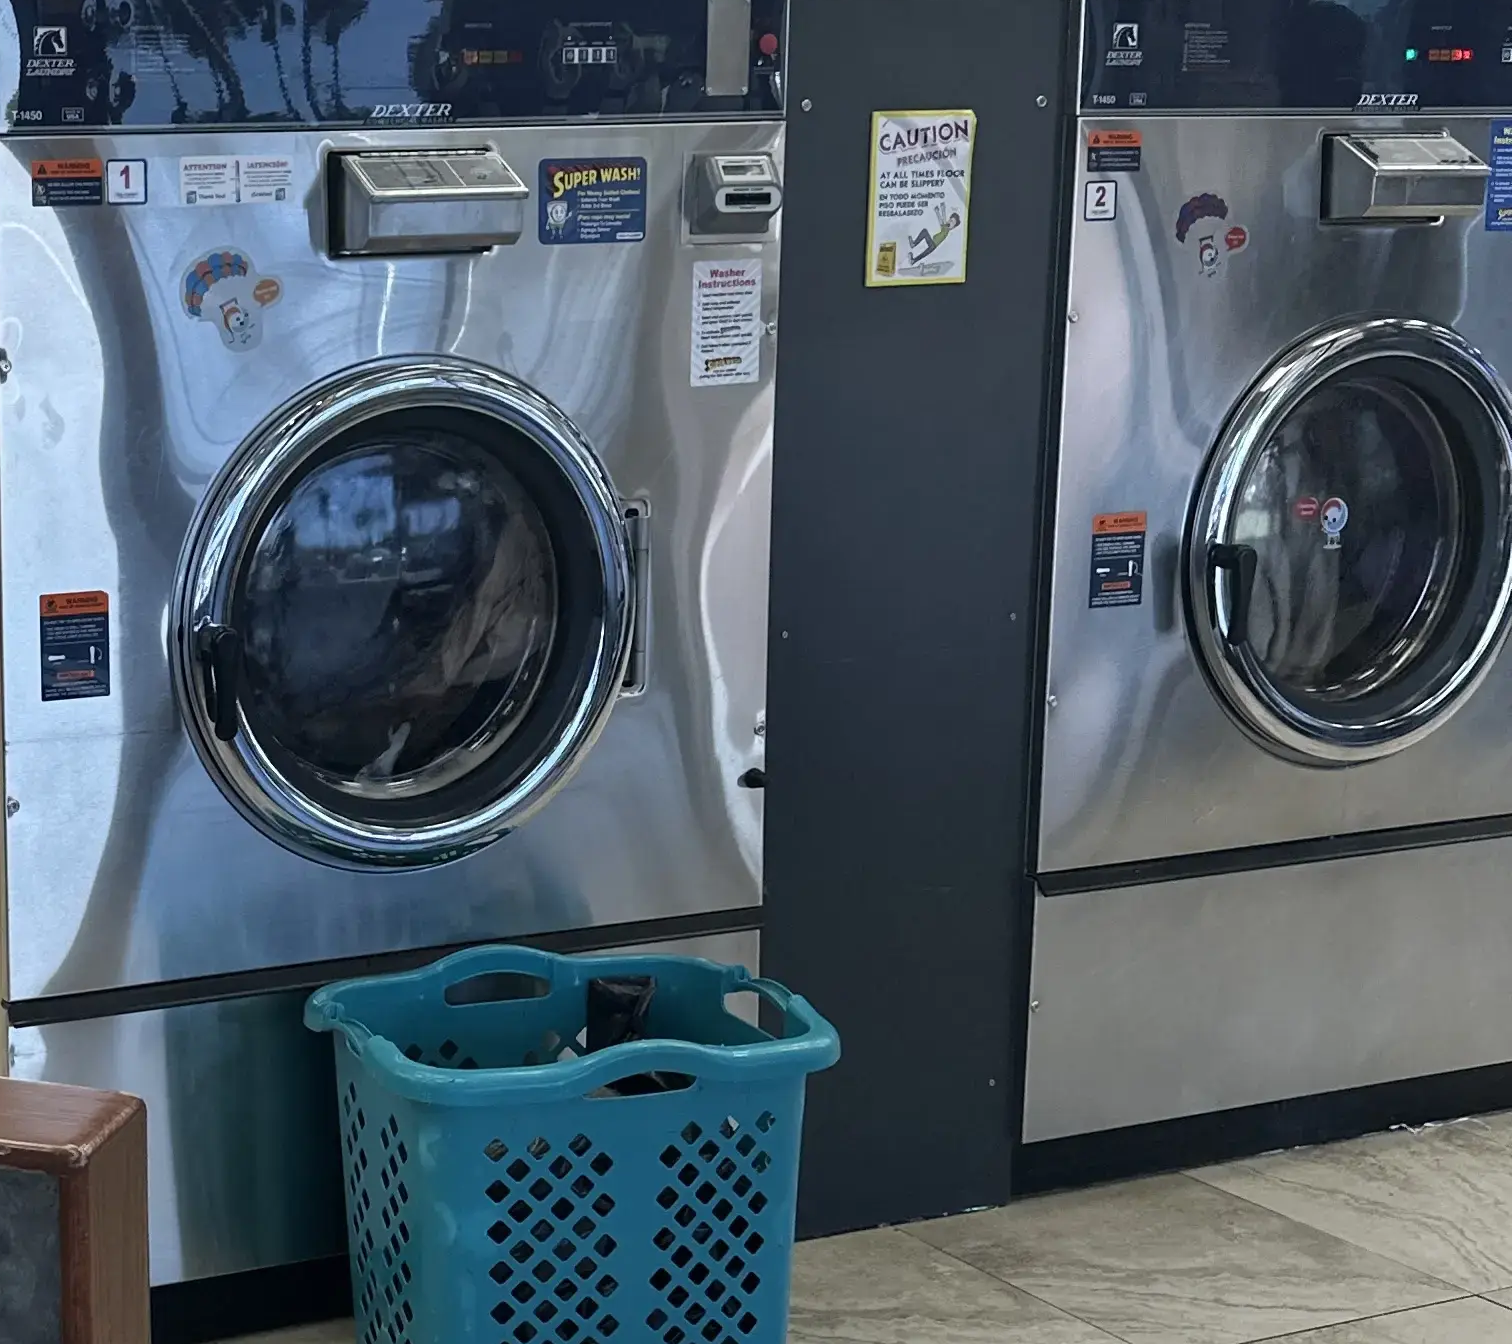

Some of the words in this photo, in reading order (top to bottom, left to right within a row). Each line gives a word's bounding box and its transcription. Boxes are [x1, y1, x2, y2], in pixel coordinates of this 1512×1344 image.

[1106, 51, 1143, 59] DEXTER
[26, 58, 76, 69] DEXTER
[26, 68, 77, 77] LAUNDRY
[1092, 94, 1117, 105] T-1450
[1356, 93, 1419, 106] DEXTER
[11, 110, 43, 121] T-1450
[369, 103, 453, 118] DEXTER
[879, 120, 969, 153] CAUTION
[897, 147, 957, 168] PRECAUCIÓN
[119, 165, 131, 190] 1
[880, 171, 890, 180] AT
[893, 171, 908, 179] ALL
[911, 170, 935, 179] TIMES
[553, 169, 598, 199] SUPER
[600, 167, 641, 184] WASH!
[879, 180, 897, 189] CAN
[899, 180, 908, 189] BE
[911, 179, 945, 188] SLIPPERY
[1095, 185, 1107, 207] 2
[710, 268, 746, 278] Washer
[698, 278, 757, 289] Instructions
